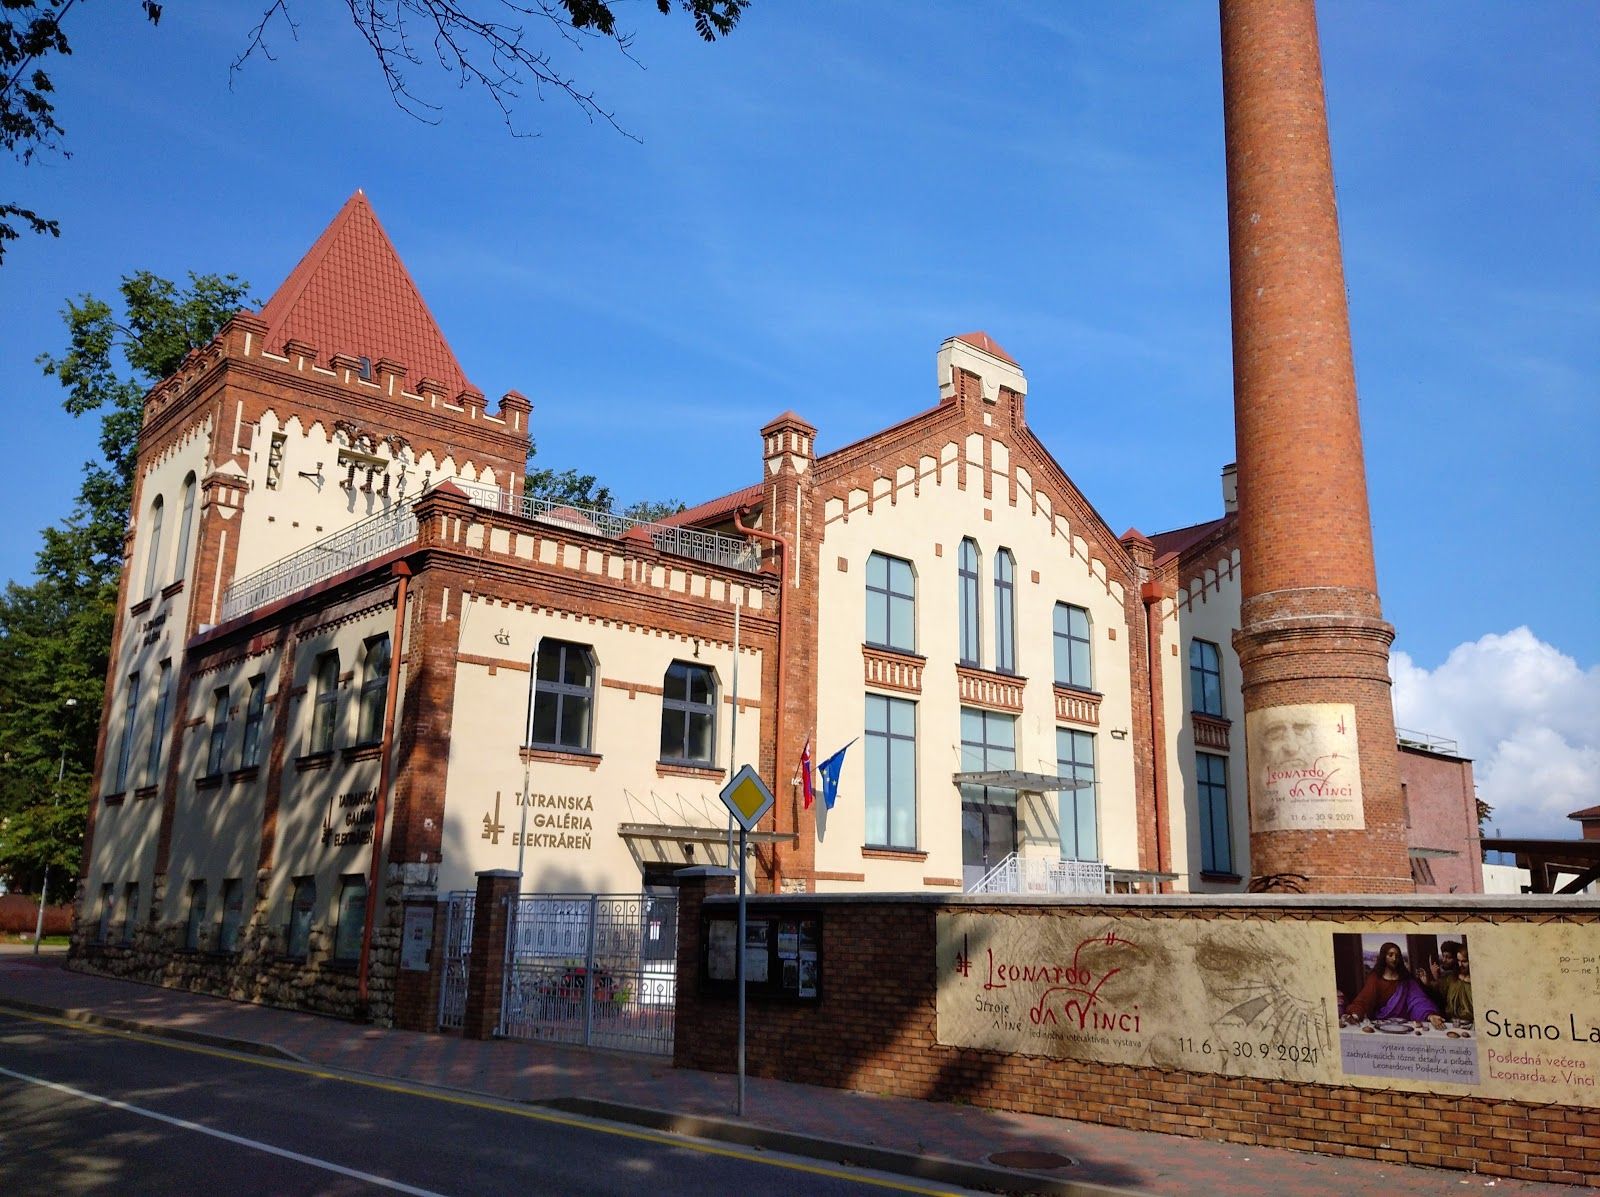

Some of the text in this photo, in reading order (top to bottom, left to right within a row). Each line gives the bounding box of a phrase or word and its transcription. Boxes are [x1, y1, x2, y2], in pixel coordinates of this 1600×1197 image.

[515, 792, 594, 811] TATRANSKÁ
[534, 813, 593, 831] GALÉRIA
[512, 832, 592, 850] EEKTRÁREŇ
[1485, 1009, 1600, 1042] Stano La
[1487, 1048, 1586, 1069] Posledná večera
[1489, 1065, 1595, 1087] Leonarda z Vinci
